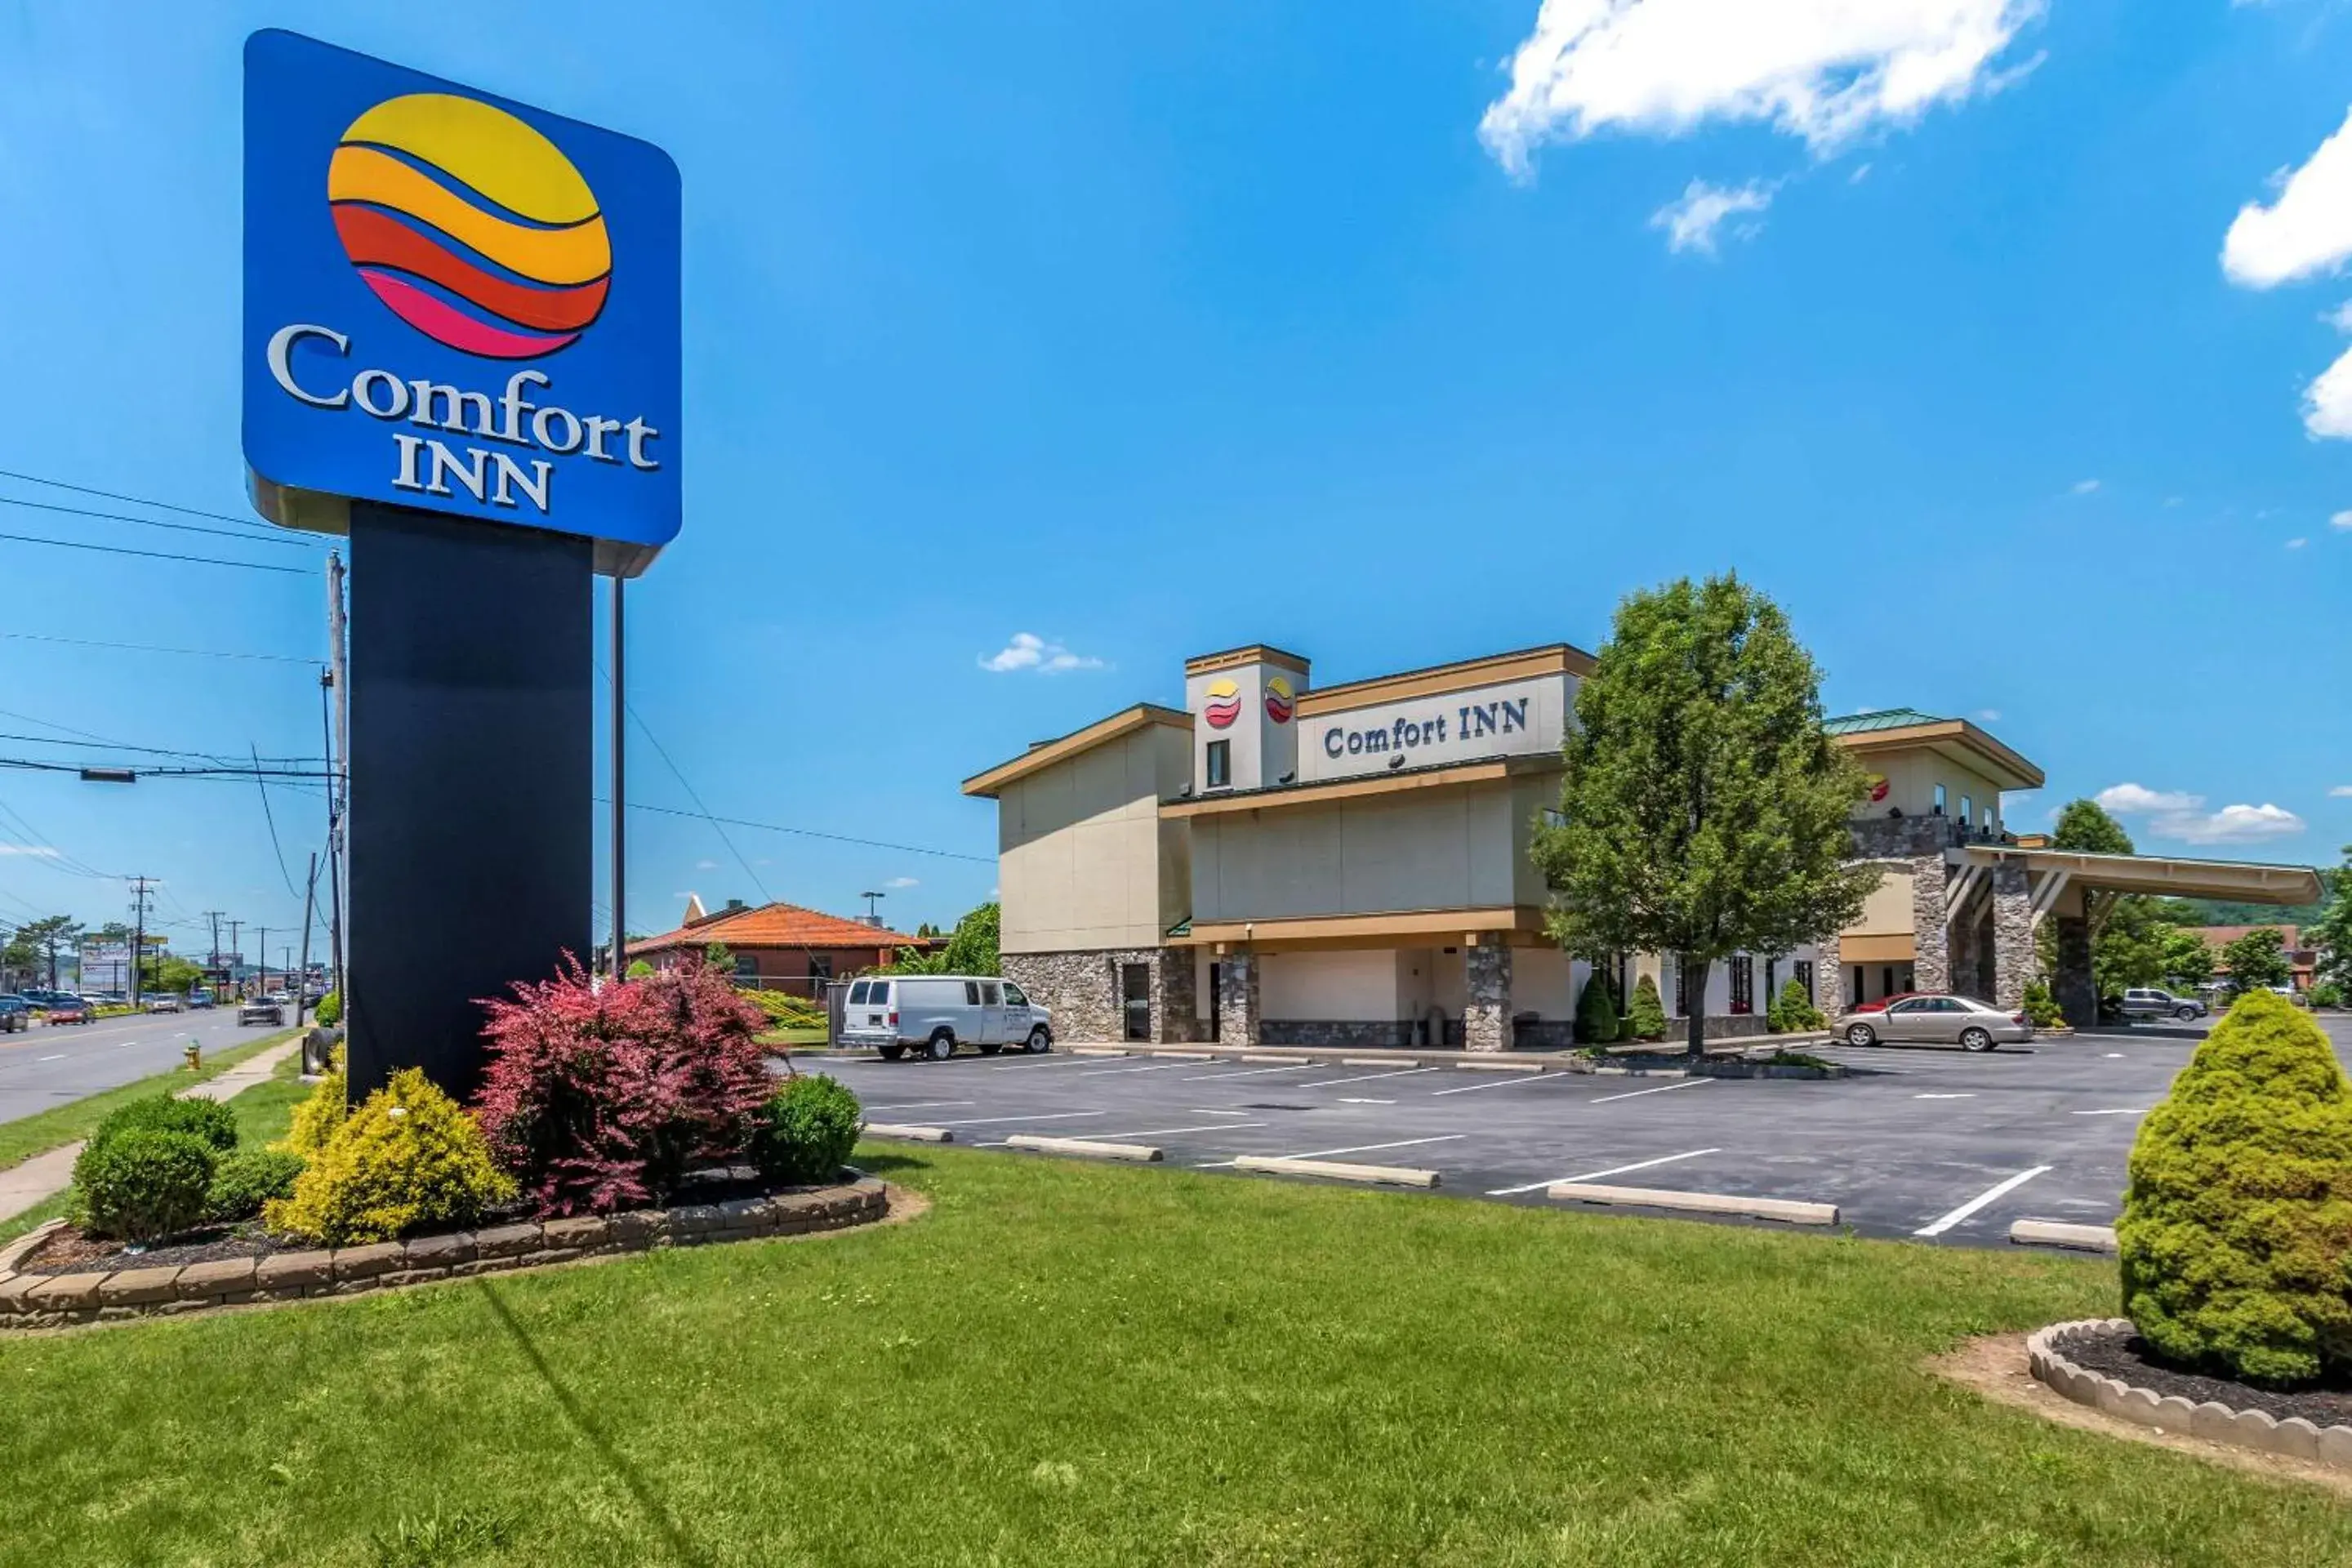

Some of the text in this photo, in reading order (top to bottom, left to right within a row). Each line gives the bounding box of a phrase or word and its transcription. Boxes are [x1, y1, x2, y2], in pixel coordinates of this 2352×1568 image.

[266, 323, 659, 469] Comfort
[391, 433, 552, 512] INN
[1324, 697, 1528, 758] Comfort INN
